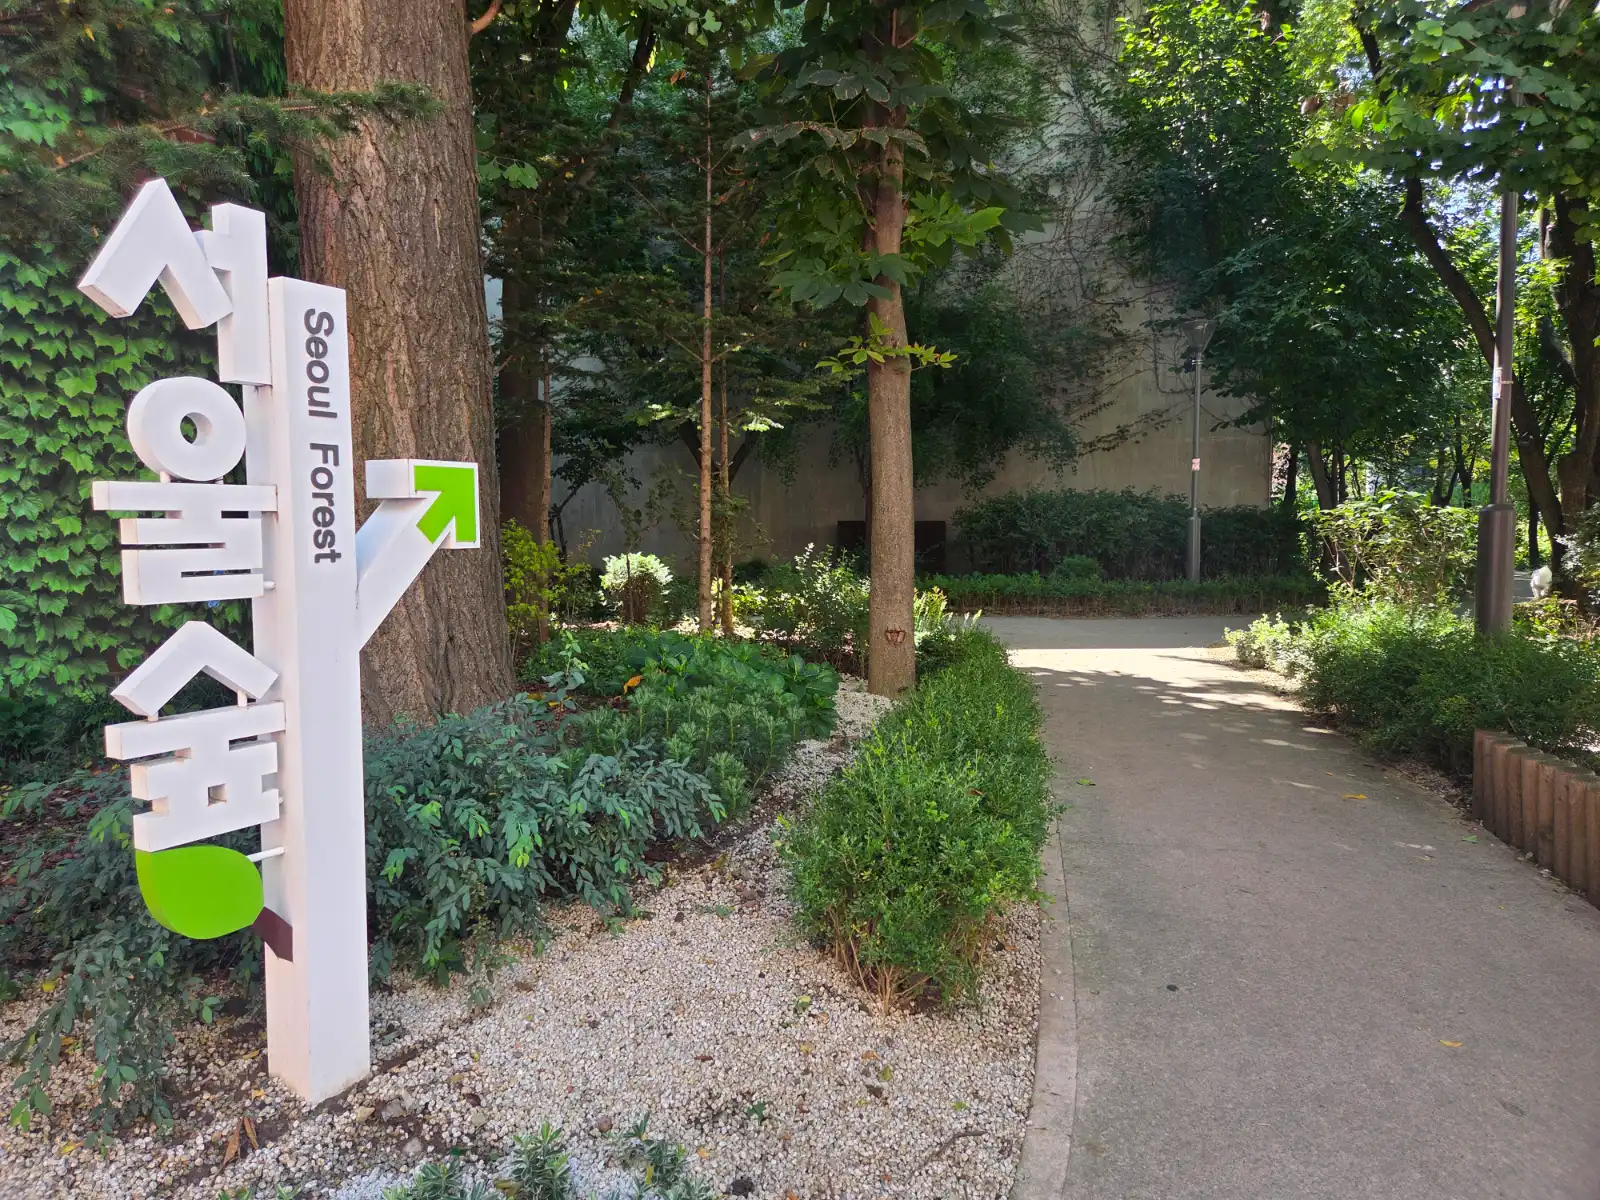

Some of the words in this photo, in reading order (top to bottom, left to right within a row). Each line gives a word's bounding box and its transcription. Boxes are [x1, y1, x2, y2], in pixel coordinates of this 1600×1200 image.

[303, 307, 338, 419] Seoul
[78, 178, 286, 853] 서울숲
[309, 442, 342, 564] Forest
